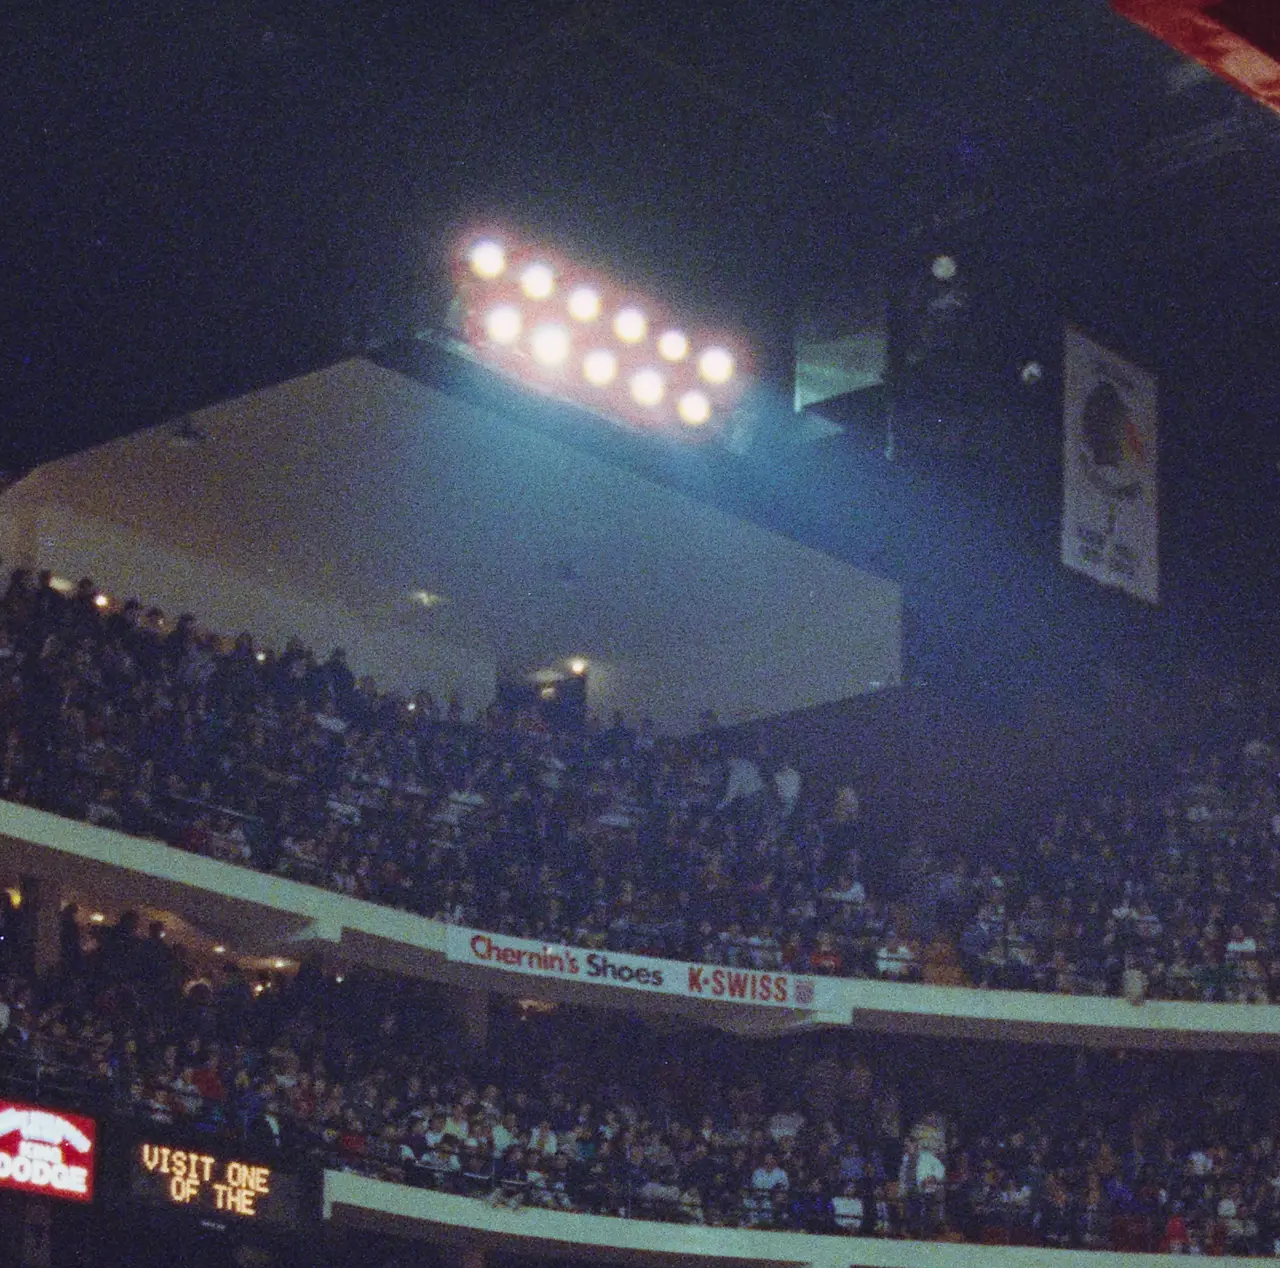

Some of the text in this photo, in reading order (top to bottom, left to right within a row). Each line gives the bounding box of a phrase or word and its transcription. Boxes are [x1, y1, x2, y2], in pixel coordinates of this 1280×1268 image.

[470, 934, 664, 988] Chernin's Shoes
[139, 1143, 272, 1194] VISIT ONE
[170, 1176, 257, 1216] OF THE
